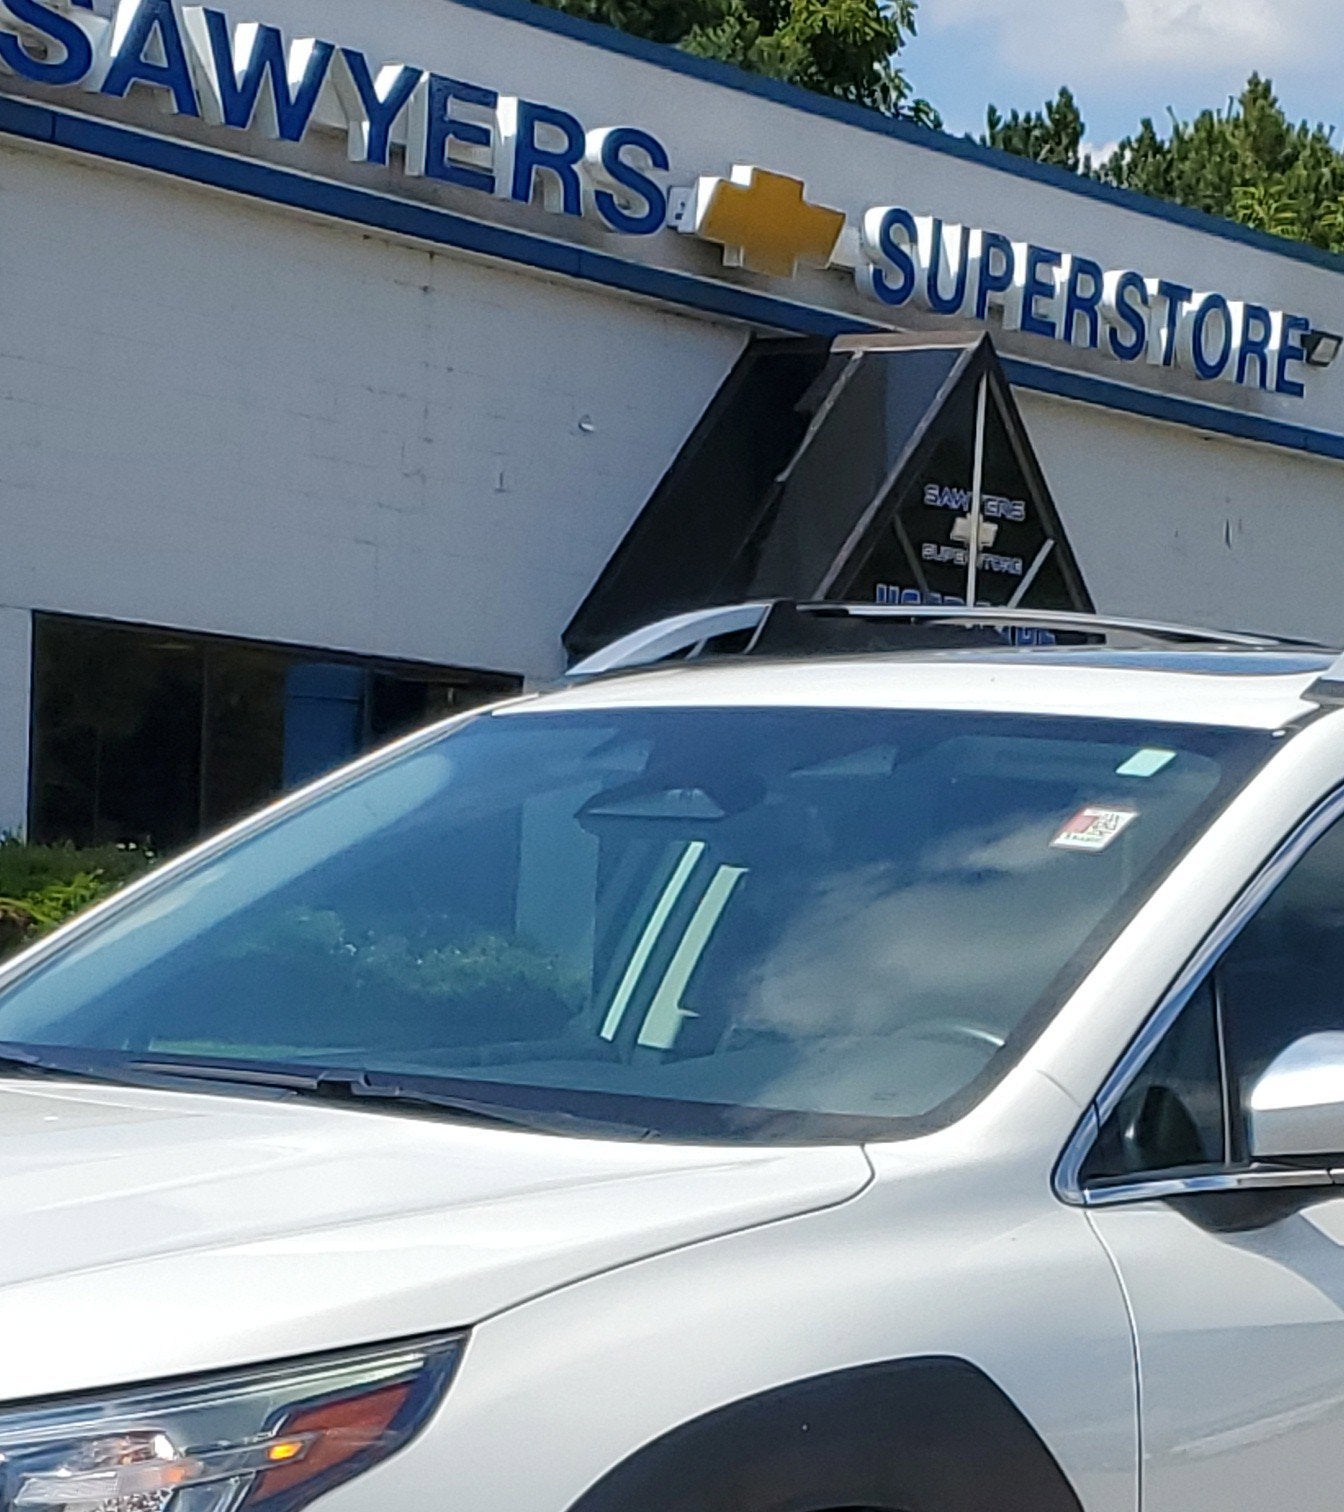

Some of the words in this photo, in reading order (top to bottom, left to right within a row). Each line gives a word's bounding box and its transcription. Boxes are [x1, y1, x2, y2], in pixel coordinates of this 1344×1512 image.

[864, 206, 1311, 399] SUPERSTORE
[924, 484, 1025, 521] SAWERS
[922, 543, 1022, 577] SUPETORE
